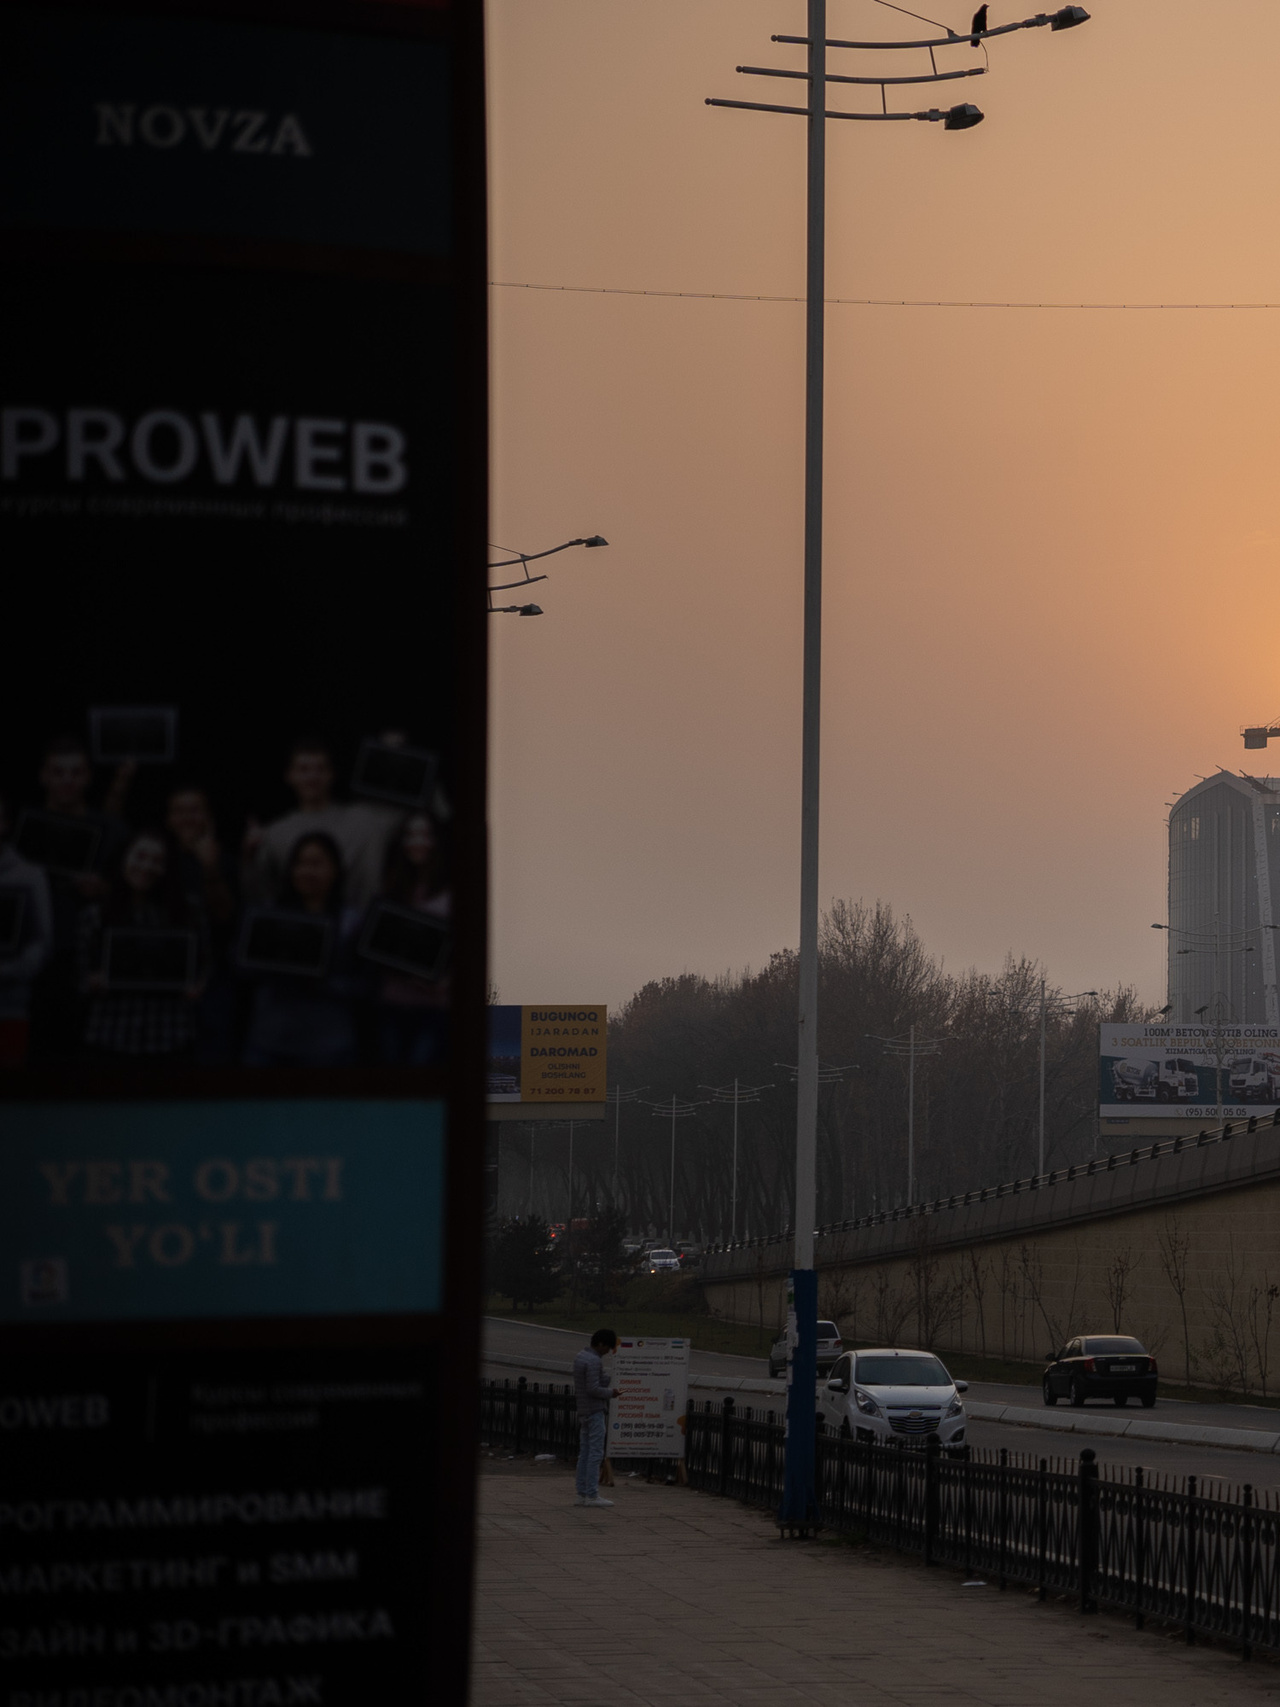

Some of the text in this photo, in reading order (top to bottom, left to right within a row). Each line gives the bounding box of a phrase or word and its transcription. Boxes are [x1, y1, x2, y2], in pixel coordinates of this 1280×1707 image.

[96, 103, 313, 157] NOVZA
[1, 406, 409, 495] PROWEB
[1112, 1037, 1118, 1047] 3
[1120, 1037, 1167, 1047] SOATLIK
[1170, 1037, 1203, 1048] BEPUL
[1175, 1028, 1209, 1038] BETON
[1244, 1028, 1278, 1038] OLING
[530, 1047, 598, 1057] DAROMAD
[1185, 1108, 1203, 1117] (95)
[1223, 1108, 1234, 1117] 05
[1236, 1108, 1247, 1117] 05
[39, 1156, 345, 1206] YER OSTI
[0, 1393, 110, 1429] OWEB
[236, 1561, 261, 1586] и
[269, 1549, 359, 1583] SMM
[114, 1628, 138, 1654] и
